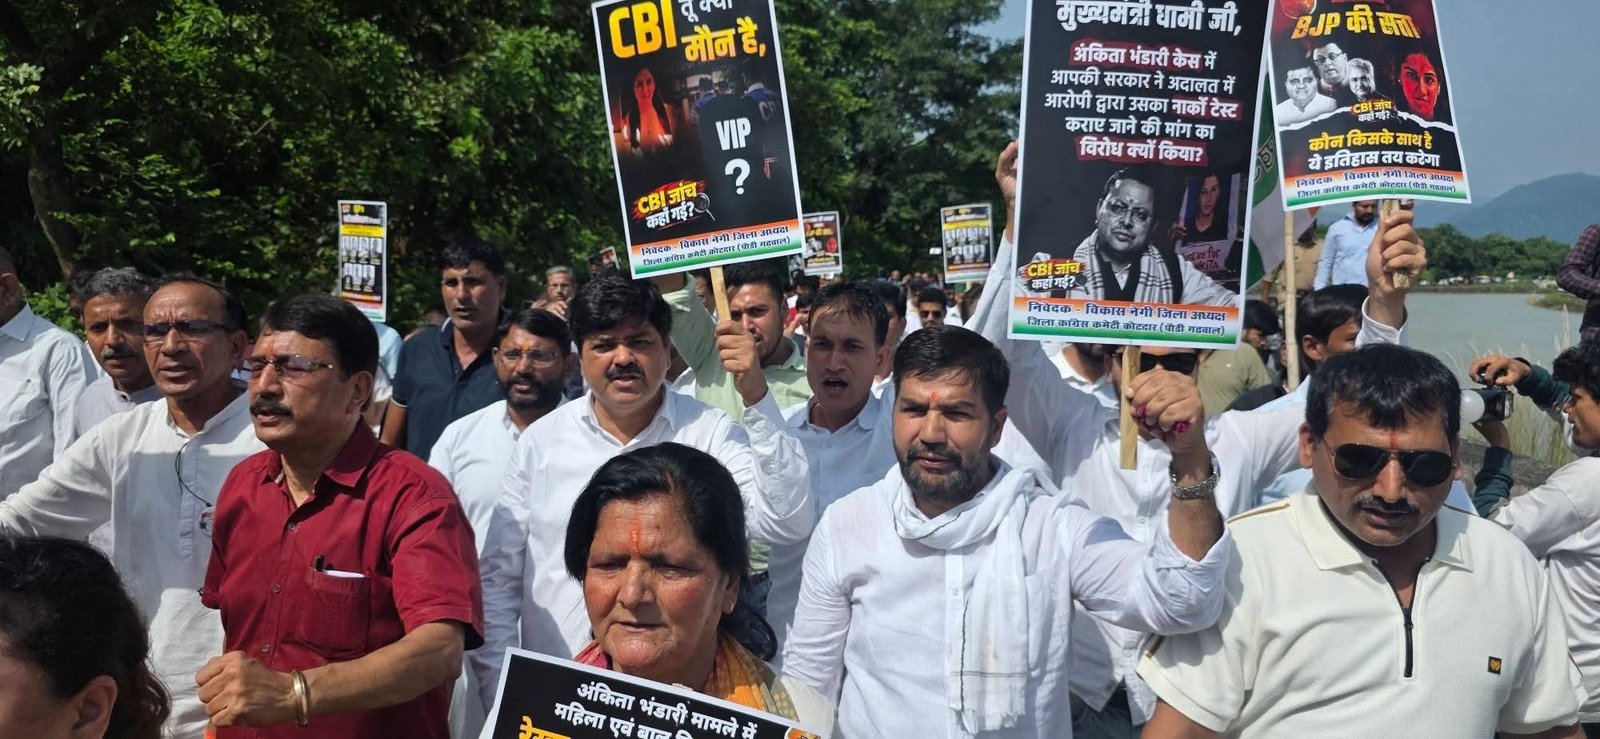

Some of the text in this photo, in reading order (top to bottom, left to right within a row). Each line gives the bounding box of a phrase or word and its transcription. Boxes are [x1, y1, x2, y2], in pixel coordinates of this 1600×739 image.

[608, 0, 677, 58] CBI
[1056, 0, 1242, 36] मुख्यमंत्री धामी जी,
[1291, 4, 1420, 39] BJP की सत्ता
[681, 16, 766, 62] मौन है,
[1073, 42, 1217, 70] अंकिता भंडारी केस में
[1050, 66, 1236, 94] आपकी सरकार ने अदालत में
[1044, 89, 1092, 109] आरोपी
[1095, 93, 1124, 114] द्वारा
[1129, 97, 1169, 114] उसका
[1210, 97, 1239, 118] टेस्ट
[1352, 100, 1392, 114] CBI जांच
[1375, 110, 1390, 121] गई?
[715, 117, 751, 150] VIP
[1065, 115, 1215, 140] कराए जाने की मांग का
[1308, 128, 1433, 151] कौन किसके साथ है
[1079, 136, 1203, 162] विरोध क्यों किया?
[1308, 149, 1441, 171] ये इतिहास तय करेगा
[724, 158, 750, 195] ?
[1296, 177, 1333, 187] निवेदक
[1344, 171, 1379, 180] विकास
[1383, 169, 1401, 178] नेगी
[1405, 170, 1427, 179] जिला
[637, 181, 698, 214] CBI जांच
[1297, 189, 1320, 198] जिला
[671, 201, 695, 221] गई?
[641, 245, 671, 255] निवेदक
[680, 238, 708, 249] विकास
[712, 232, 730, 242] नेगी
[733, 230, 757, 240] जिला
[760, 226, 788, 237] अध्यक्ष
[643, 257, 663, 266] जिला
[1027, 260, 1080, 277] CBI जांच
[1054, 274, 1076, 289] गई?
[1027, 316, 1055, 326] जिला
[1092, 319, 1120, 329] कमेटी
[1028, 301, 1071, 313] निवेदक
[1085, 302, 1126, 316] विकास
[1130, 305, 1153, 317] नेगी
[1157, 307, 1188, 319] जिला
[1190, 311, 1225, 321] अध्यक्ष
[554, 701, 607, 729] महिला
[609, 717, 635, 738] एवं
[577, 681, 758, 739] अंकिता भंडारी मामले में
